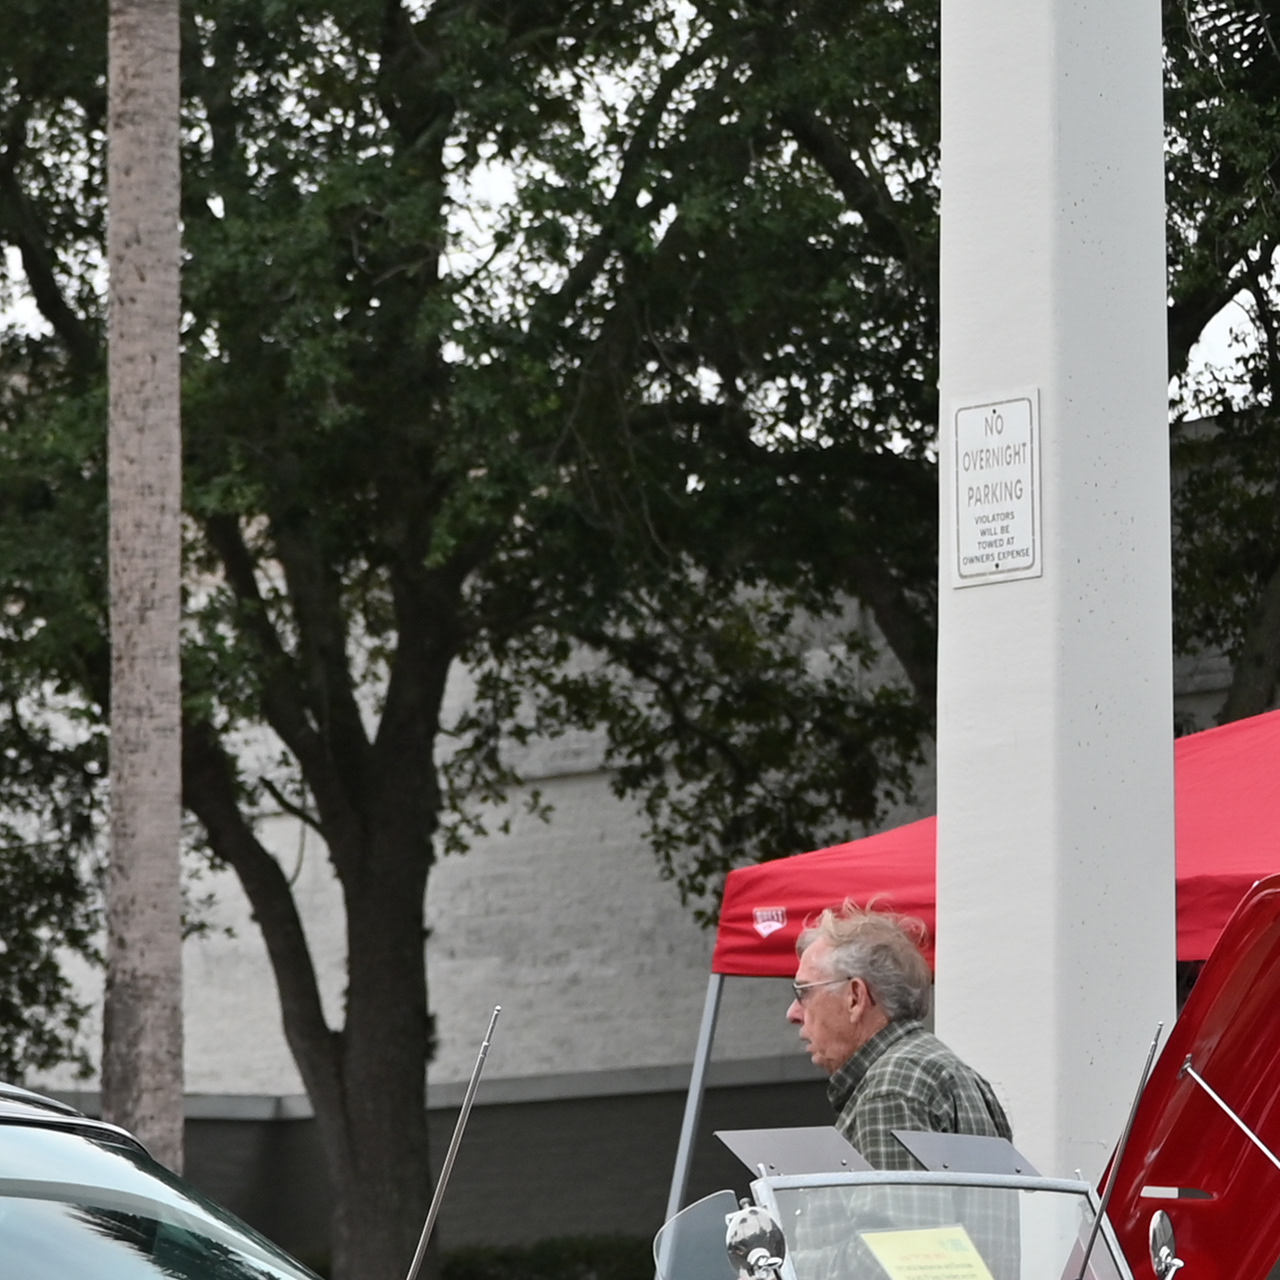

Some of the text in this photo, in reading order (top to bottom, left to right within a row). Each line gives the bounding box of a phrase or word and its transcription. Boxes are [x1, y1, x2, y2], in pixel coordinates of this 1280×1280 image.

[984, 414, 1004, 437] NO
[963, 443, 1027, 472] OVERNIGHT
[967, 479, 1023, 507] PARKING
[974, 511, 1015, 525] VIOLATORS
[980, 525, 1010, 537] WILL BE
[977, 536, 1015, 550] TOWED AT
[962, 547, 1030, 566] OWNERS EXPENSE
